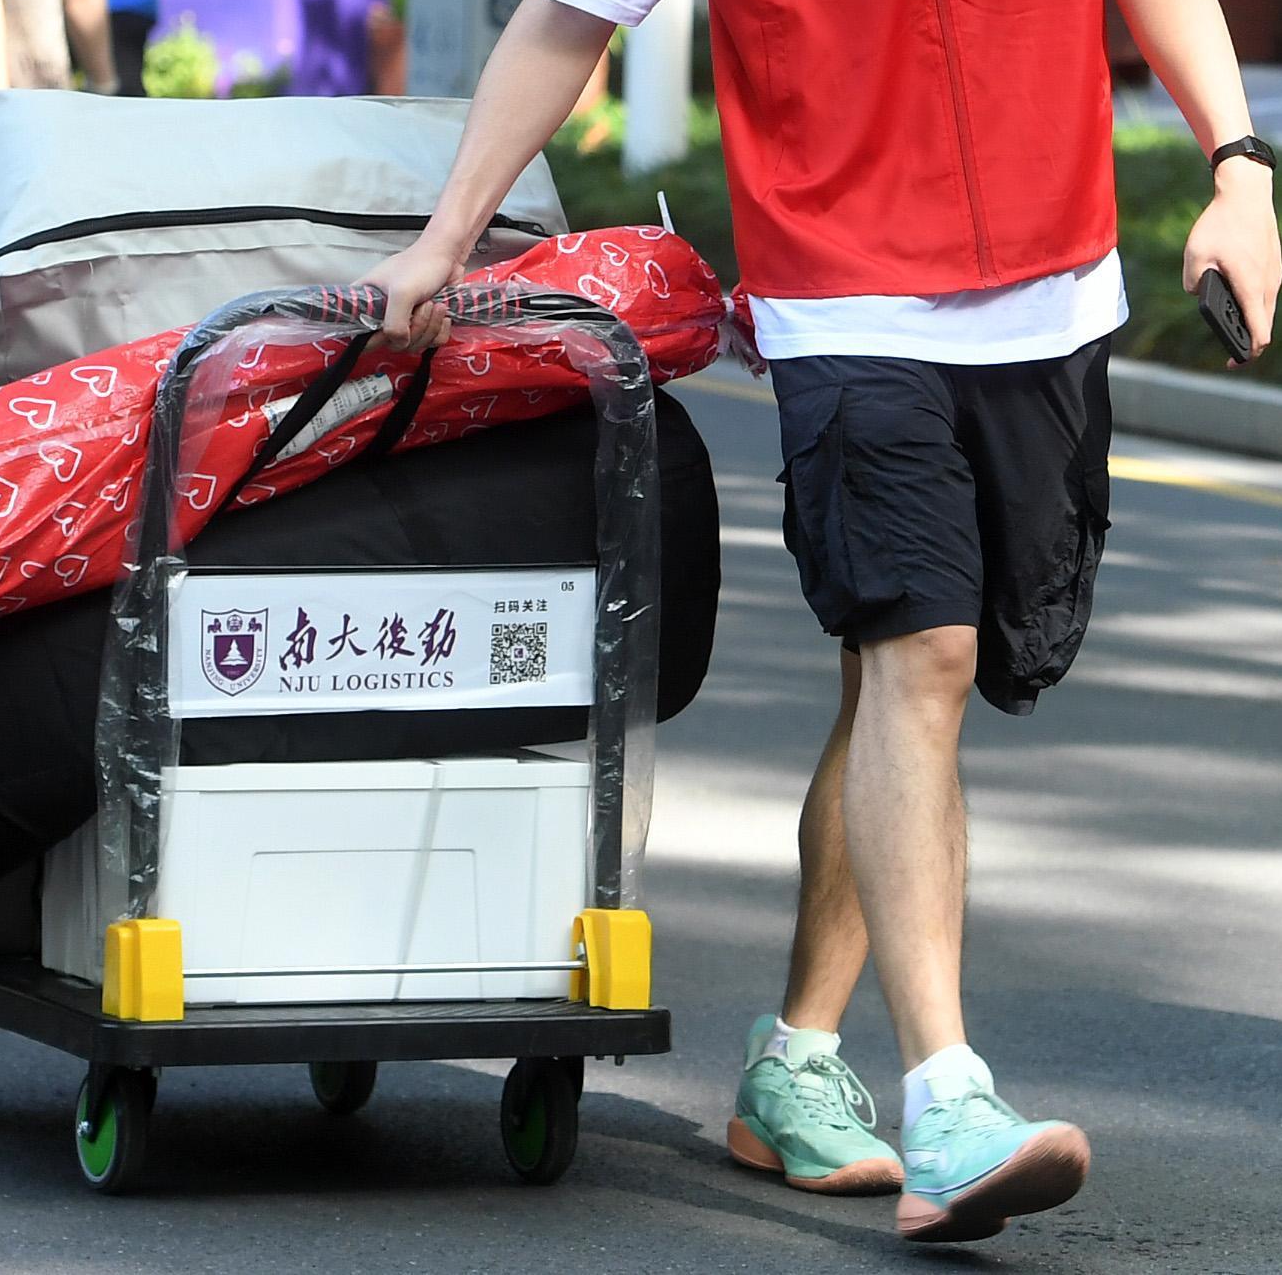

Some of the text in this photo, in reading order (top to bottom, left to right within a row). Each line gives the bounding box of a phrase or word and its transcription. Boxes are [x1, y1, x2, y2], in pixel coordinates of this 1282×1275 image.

[560, 581, 575, 592] 05
[494, 598, 548, 613] 扫码关注
[205, 648, 263, 690] NANJING UNIVERSITY
[279, 671, 455, 693] NJU LOGISTICS
